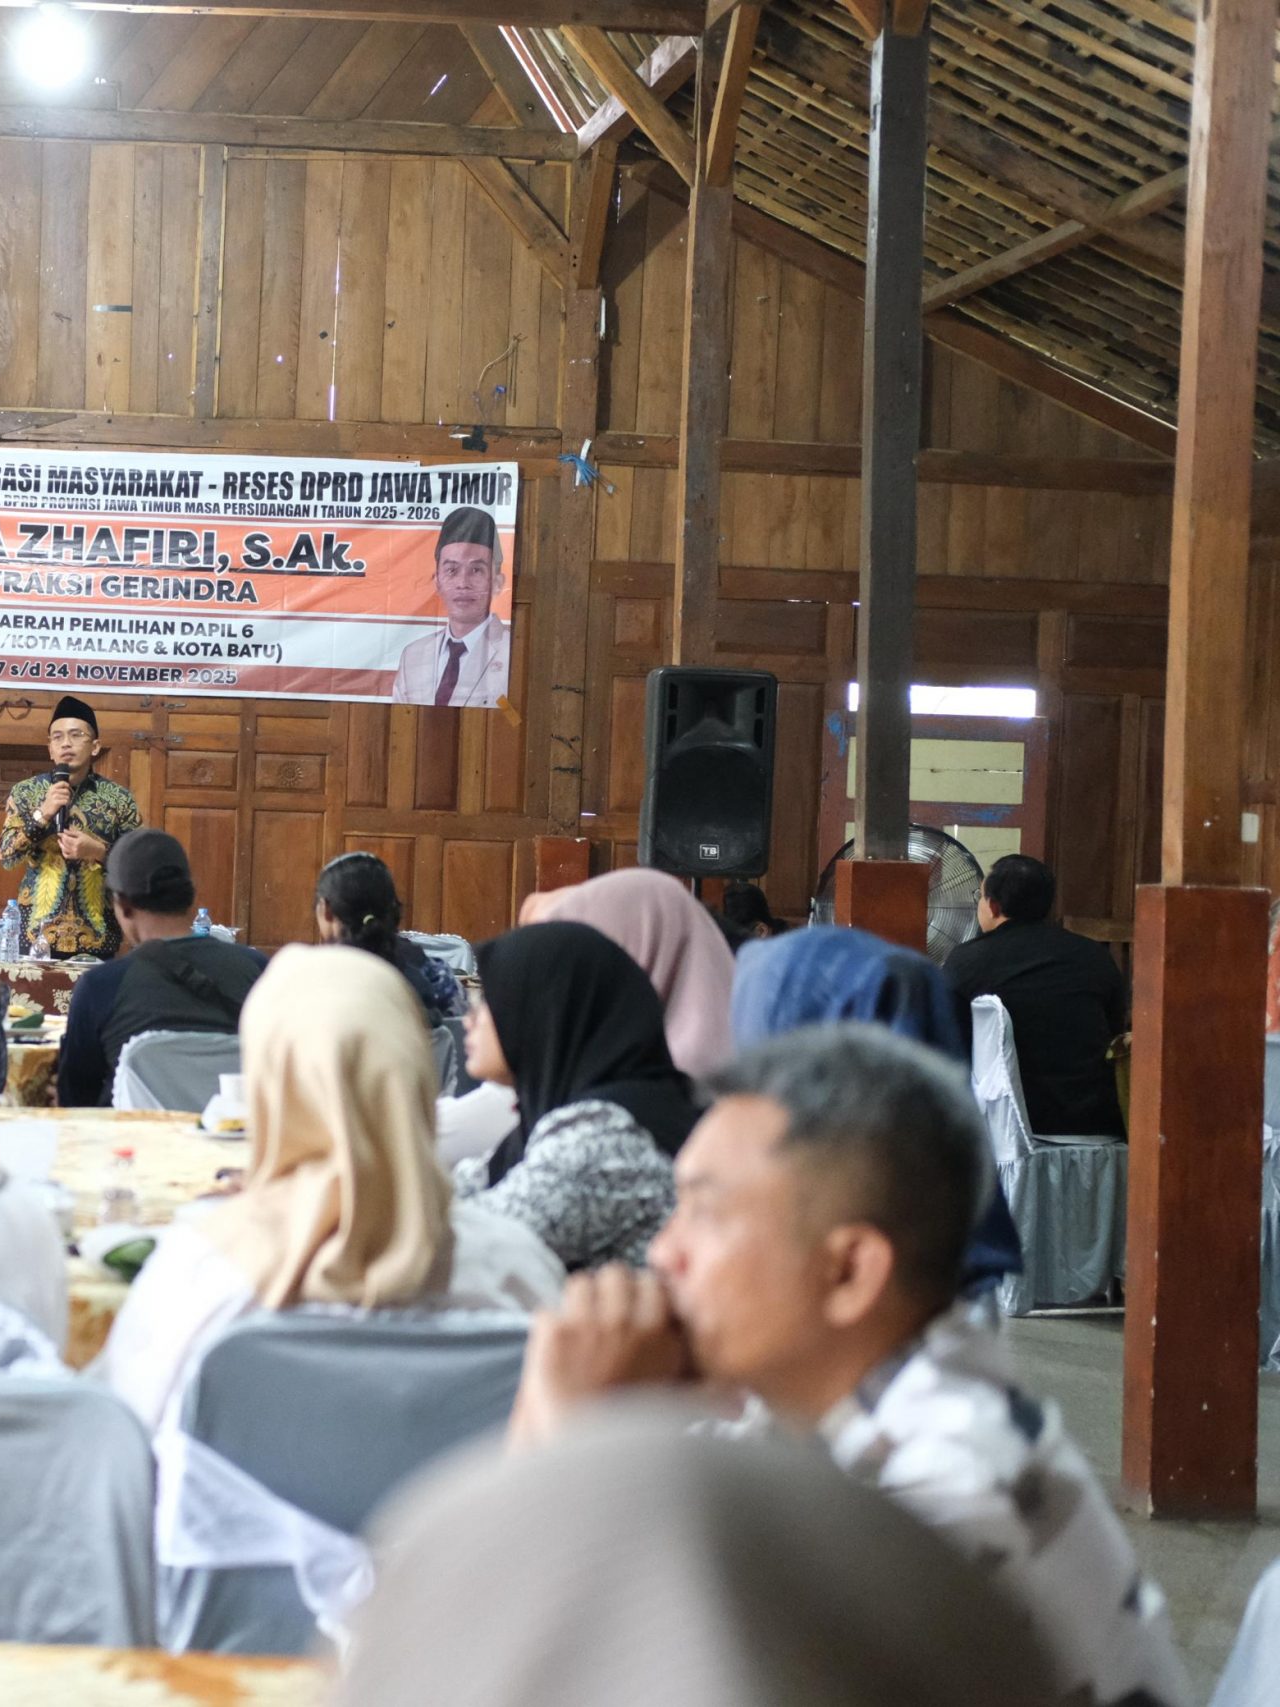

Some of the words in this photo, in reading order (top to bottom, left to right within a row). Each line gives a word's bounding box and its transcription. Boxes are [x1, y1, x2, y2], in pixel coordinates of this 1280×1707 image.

[47, 466, 203, 499] MASYARAKAT
[223, 471, 295, 501] RESES
[300, 471, 363, 503] DPRD
[368, 472, 432, 504] JAWA
[438, 472, 513, 506] TIMUR
[4, 494, 38, 508] DPRD
[41, 496, 101, 511] PROVINSI
[104, 499, 138, 512] JAWA
[141, 500, 181, 513] TIMUR
[185, 502, 220, 515] MASA
[224, 503, 310, 519] PERSIDANGAN
[313, 505, 318, 518] I
[320, 505, 361, 519] TAHUN
[365, 506, 397, 520] 2025
[407, 507, 440, 521] 2026
[17, 523, 230, 574] ZHAFIRI,
[242, 531, 366, 571] S.Ak.
[101, 575, 258, 603] GERINDRA
[70, 617, 175, 636] PEMILIHAN
[180, 621, 237, 638] DAPIL
[241, 624, 254, 639] 6
[67, 637, 149, 654] MALANG
[153, 641, 168, 656] &
[173, 642, 223, 657] KOTA
[227, 643, 283, 664] BATU)
[10, 662, 40, 677] s/d
[45, 663, 69, 678] 24
[76, 665, 183, 683] NOVEMBER
[188, 668, 237, 685] 2025
